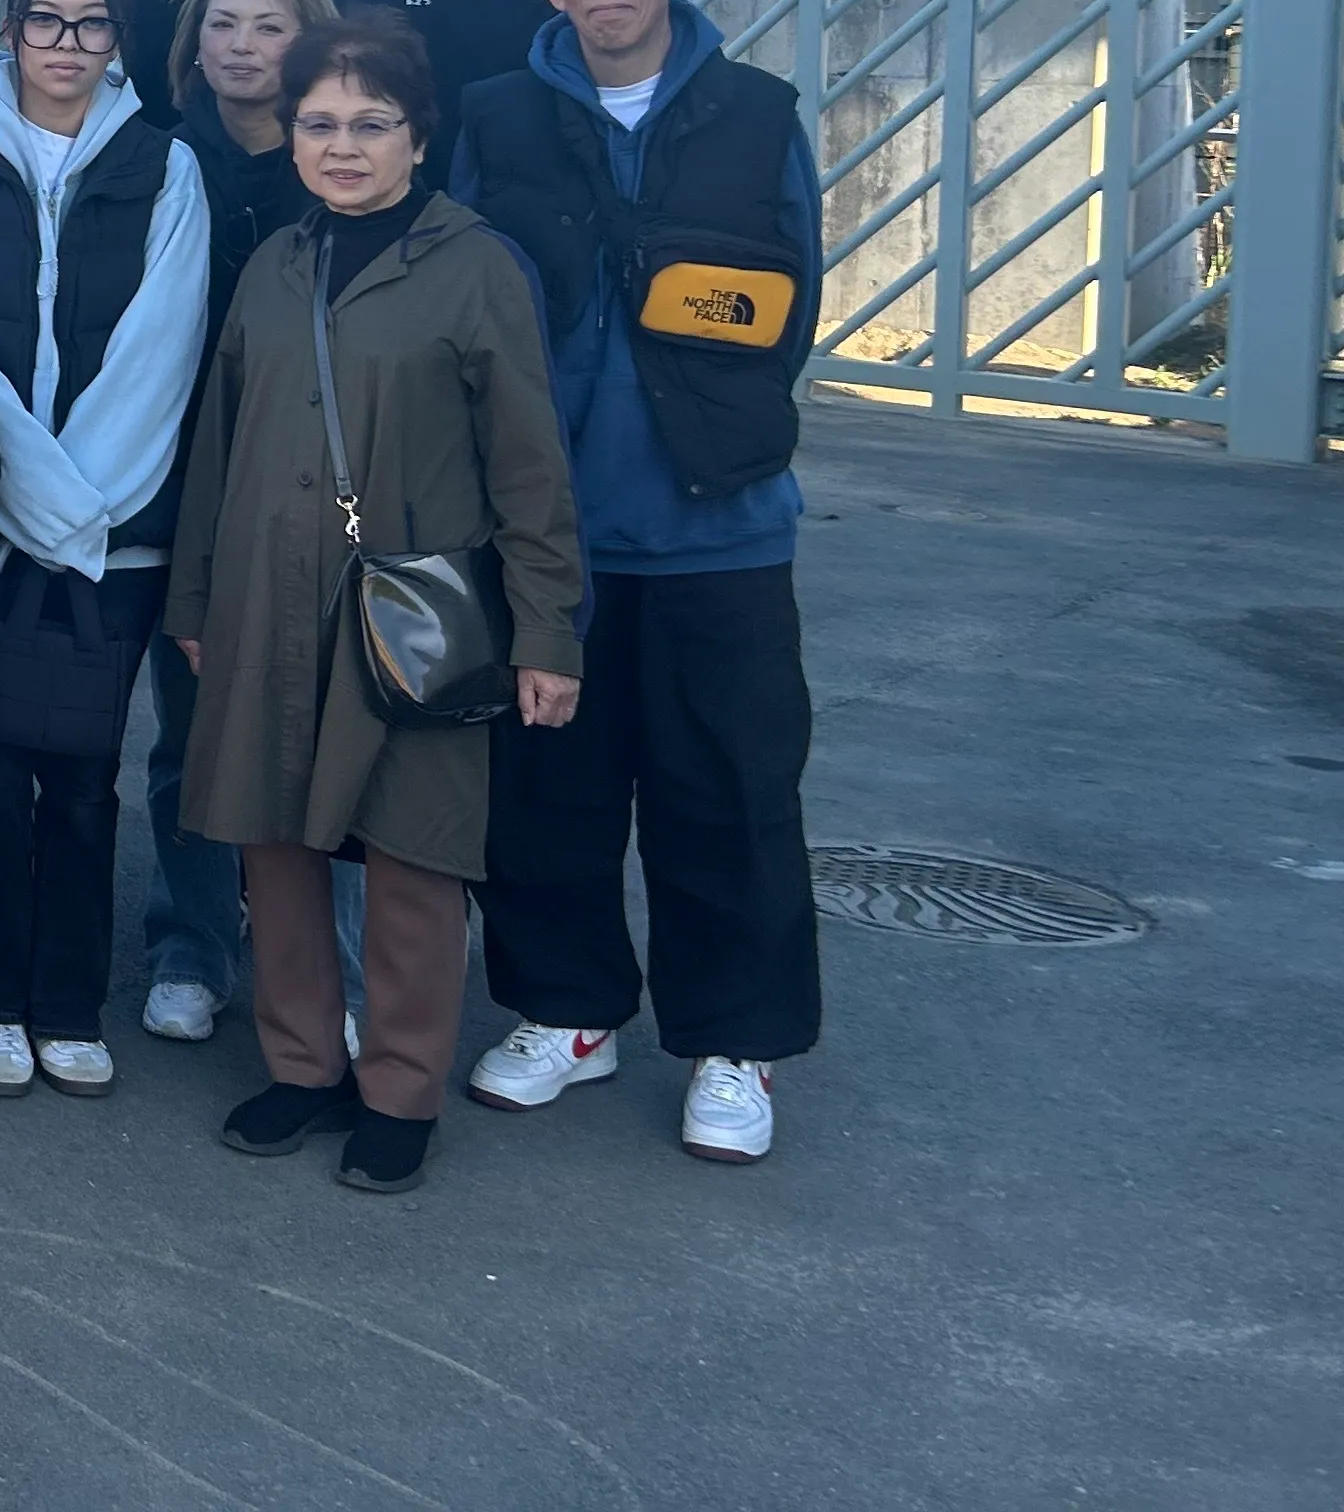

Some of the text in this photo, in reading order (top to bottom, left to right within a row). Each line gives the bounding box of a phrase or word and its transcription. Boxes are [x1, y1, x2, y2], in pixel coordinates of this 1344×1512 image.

[711, 289, 736, 302] THE
[683, 296, 733, 312] NORTH
[694, 309, 730, 323] FACE
